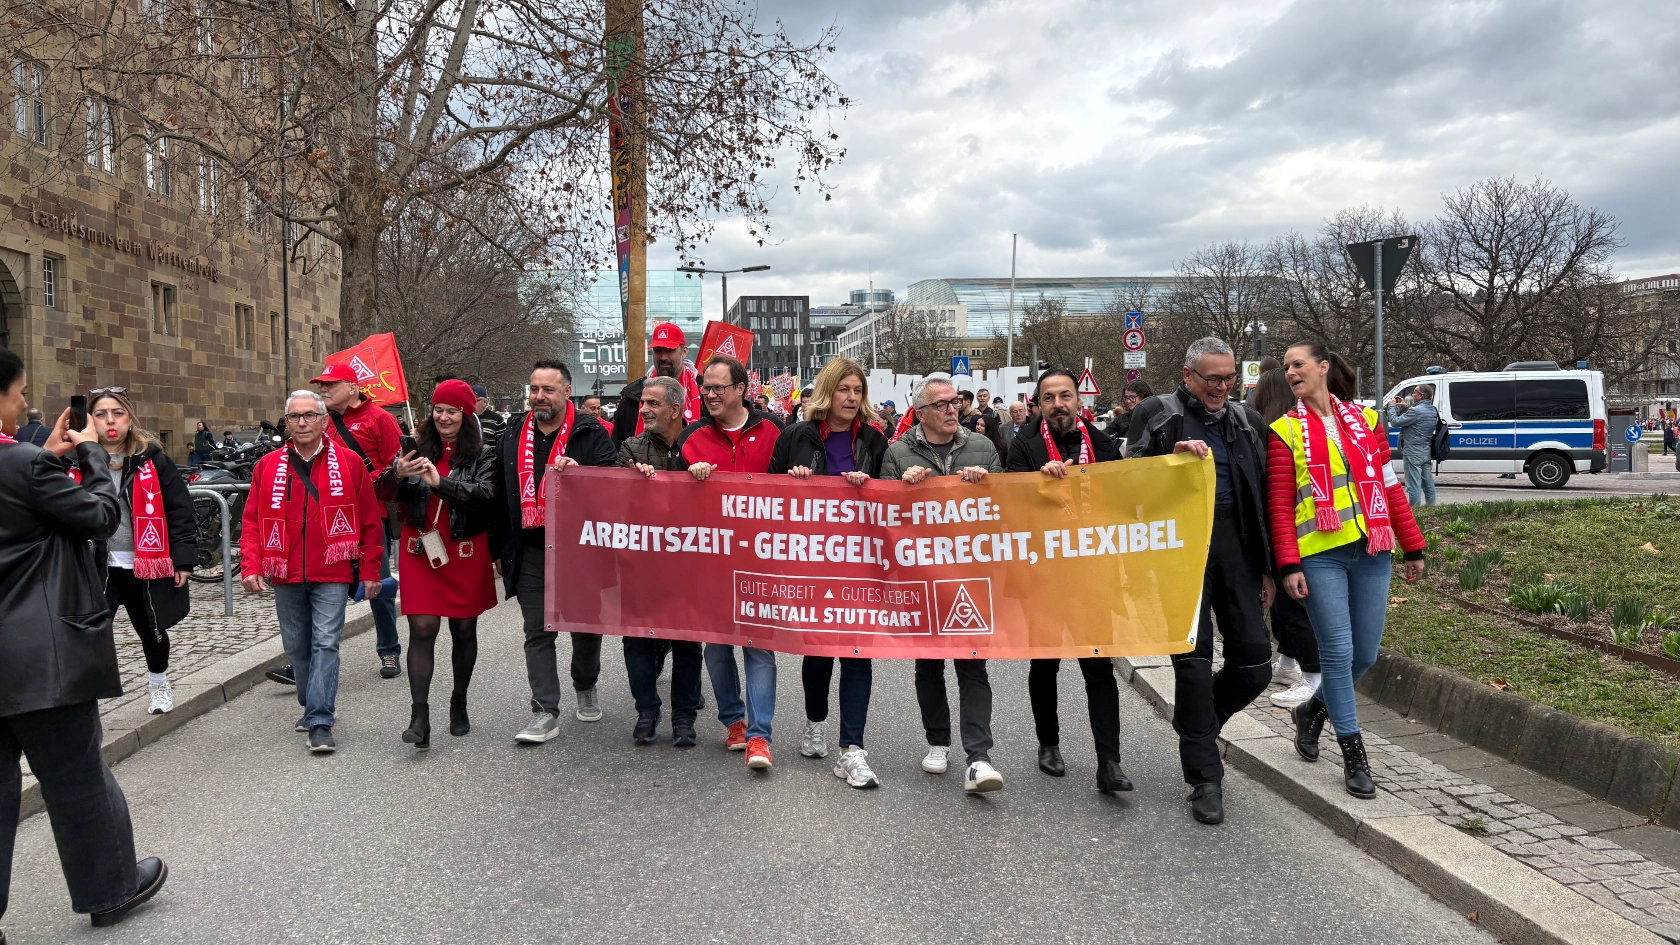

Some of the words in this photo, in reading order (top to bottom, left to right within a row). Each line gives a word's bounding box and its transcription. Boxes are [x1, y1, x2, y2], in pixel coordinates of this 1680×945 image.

[31, 203, 143, 257] Landesmuseum
[583, 363, 626, 376] tungen
[721, 494, 784, 521] KEINE
[790, 497, 1000, 527] LIFESTYLE-FRAGE:
[579, 520, 734, 555] ARBEITSZEIT
[754, 532, 890, 571] GEREGELT,
[894, 531, 1038, 567] GERECHT,
[1044, 518, 1184, 559] FLEXIBEL
[740, 580, 768, 597] GUTE
[770, 584, 816, 600] ARBEIT
[841, 586, 881, 602] GUTES
[884, 588, 920, 605] LEBEN
[740, 601, 755, 617] IG
[758, 603, 818, 623] METALL
[823, 607, 922, 627] STUTTGART
